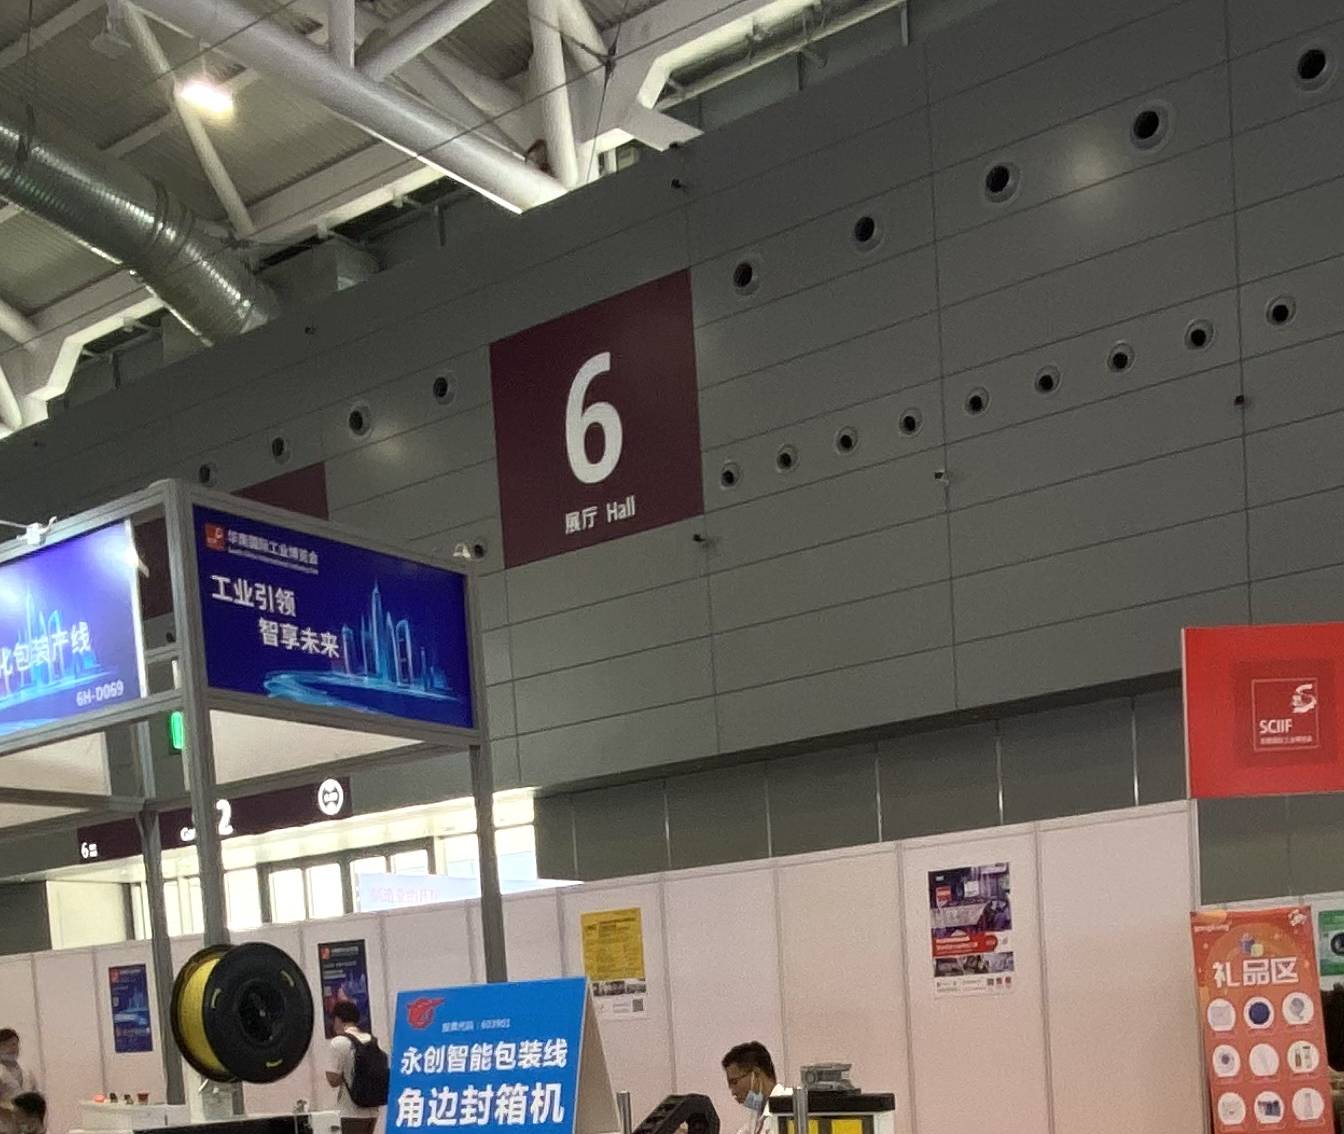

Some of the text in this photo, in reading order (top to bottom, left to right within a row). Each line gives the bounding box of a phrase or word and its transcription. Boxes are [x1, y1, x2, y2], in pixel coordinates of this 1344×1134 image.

[565, 351, 624, 485] 6
[564, 494, 637, 535] 展厅 Hall
[209, 573, 297, 618] 工业引领
[257, 616, 340, 659] 智享未来
[1259, 718, 1293, 735] SCIIF
[1212, 956, 1300, 988] 礼品区
[399, 1038, 568, 1076] 永创智能包装线
[395, 1082, 565, 1129] 角边封箱机
